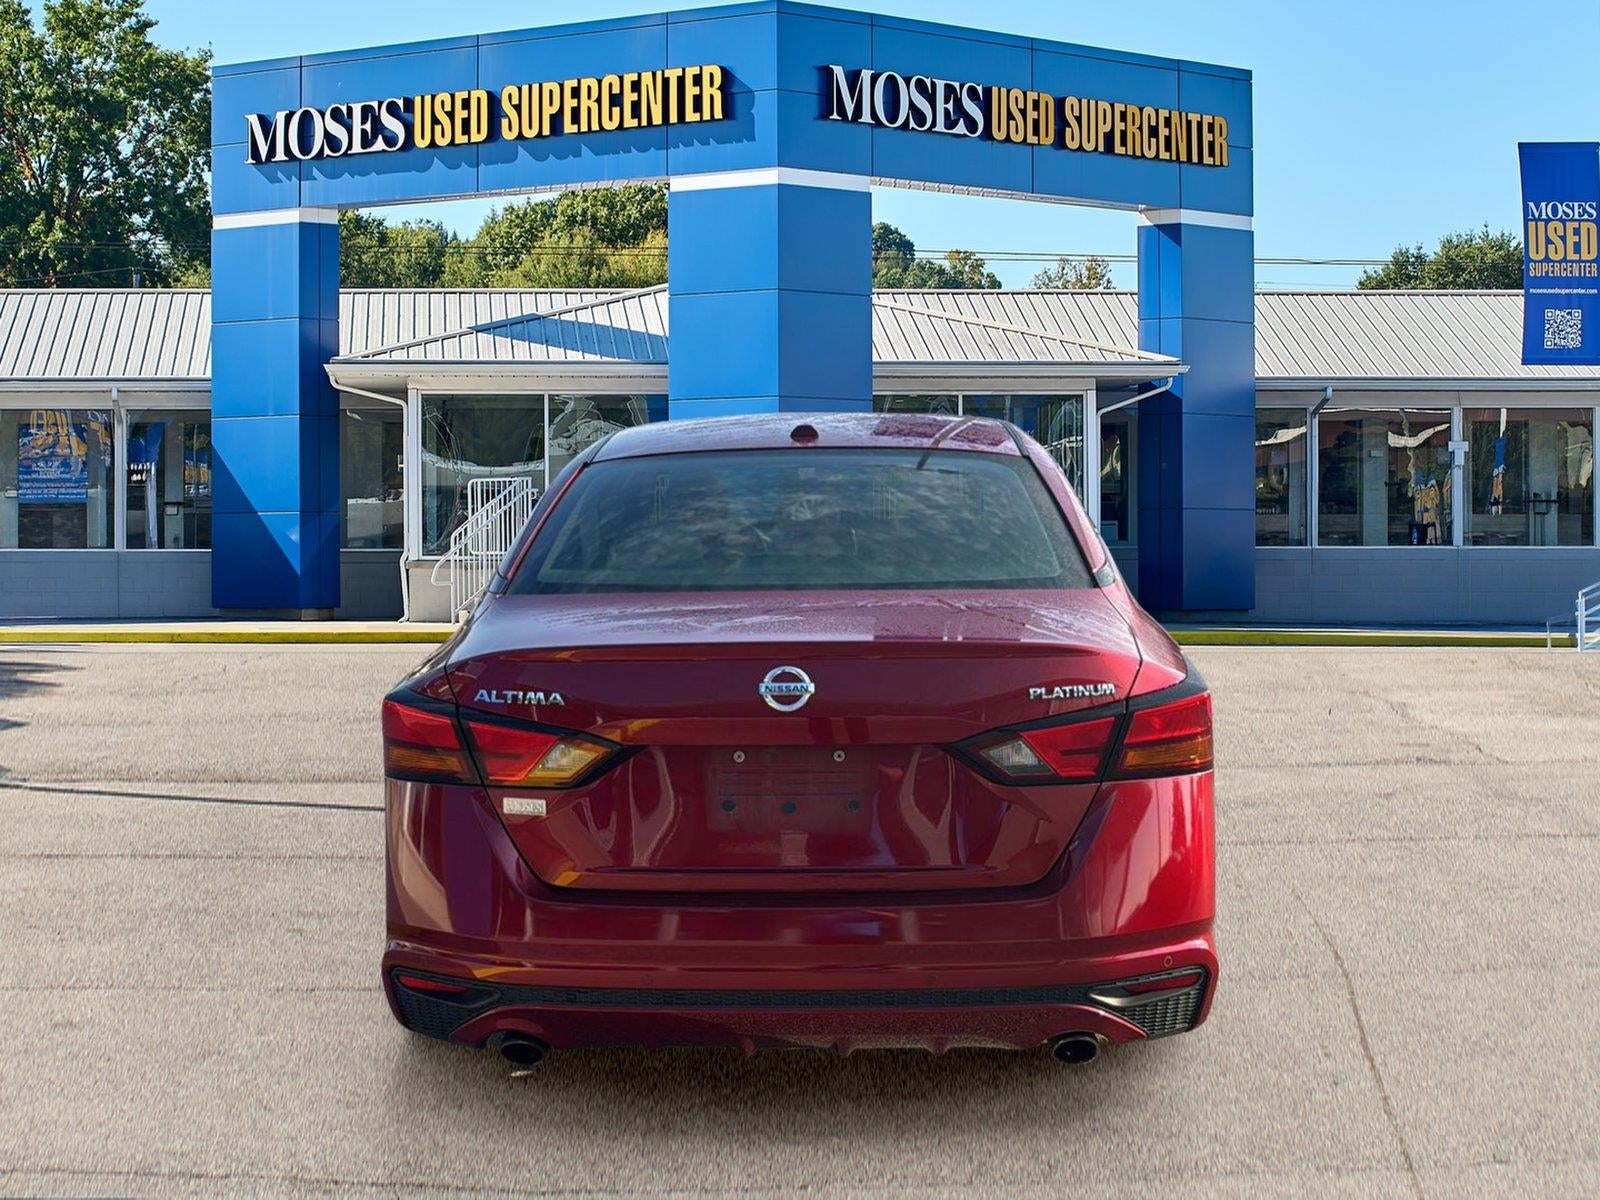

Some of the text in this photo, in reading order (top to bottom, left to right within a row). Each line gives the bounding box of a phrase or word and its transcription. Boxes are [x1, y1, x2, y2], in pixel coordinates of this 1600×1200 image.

[244, 64, 724, 165] MOSES USED SUPERCENTER
[829, 64, 1230, 167] MOSES USED SUPERCENTER
[1527, 201, 1597, 219] MOSES
[1528, 221, 1598, 261] USED
[1529, 263, 1598, 277] SUPERCENTER
[473, 688, 565, 706] ALTIMA
[764, 683, 810, 694] NISSAN
[1028, 683, 1116, 700] PLATINUM
